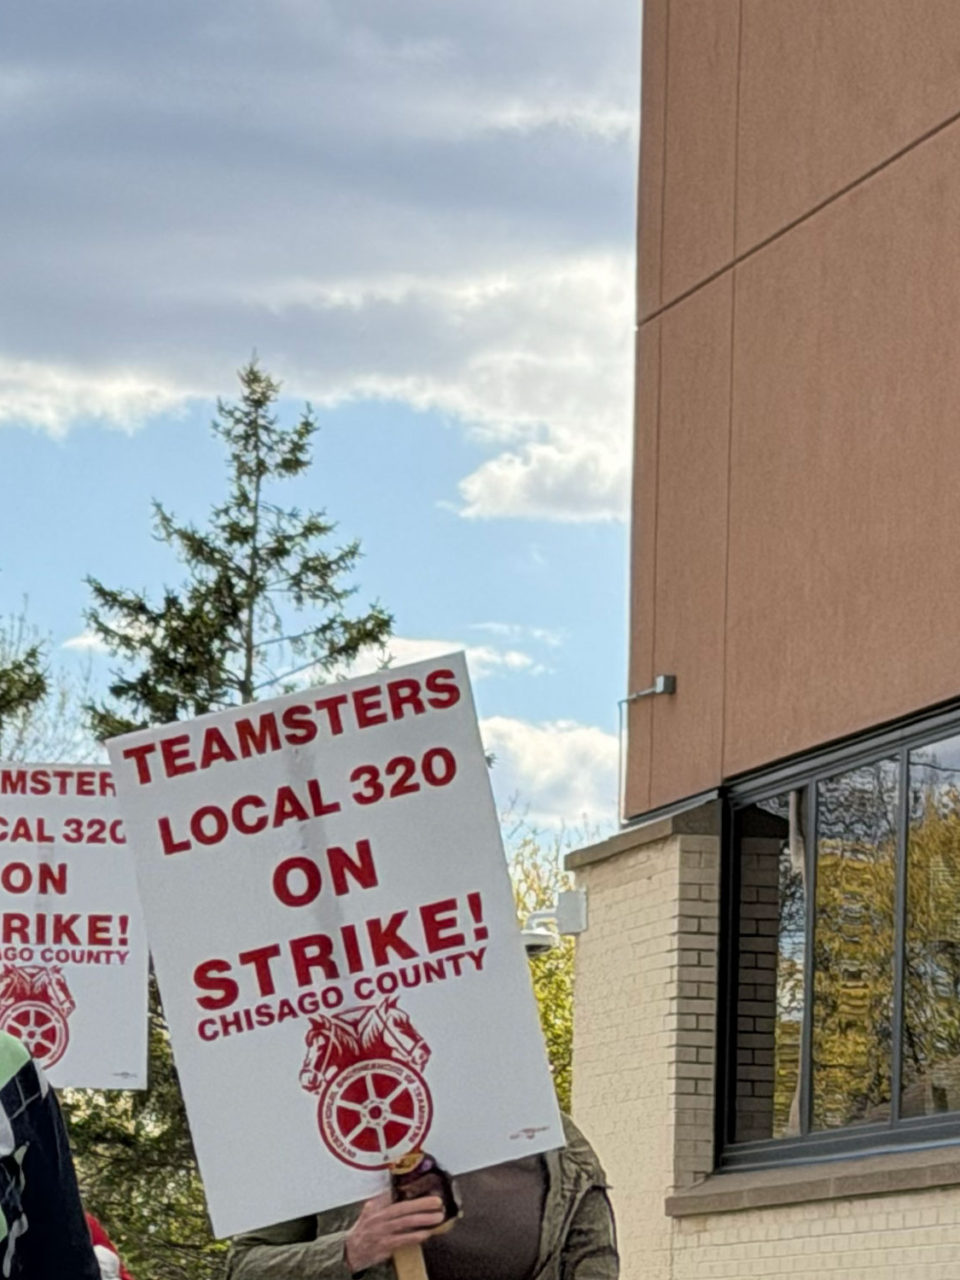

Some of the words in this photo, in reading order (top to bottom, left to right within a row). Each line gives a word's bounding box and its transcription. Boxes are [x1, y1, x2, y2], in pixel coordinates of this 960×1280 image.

[123, 669, 461, 785] TEAMSTERS
[158, 779, 340, 856] LOCAL
[350, 747, 457, 805] 320
[1, 861, 68, 895] ON
[272, 839, 379, 907] ON
[40, 947, 129, 965] COUNTY
[193, 892, 489, 1010] STRIKE!
[198, 986, 343, 1041] CHISAGO
[354, 947, 487, 1000] COUNTY
